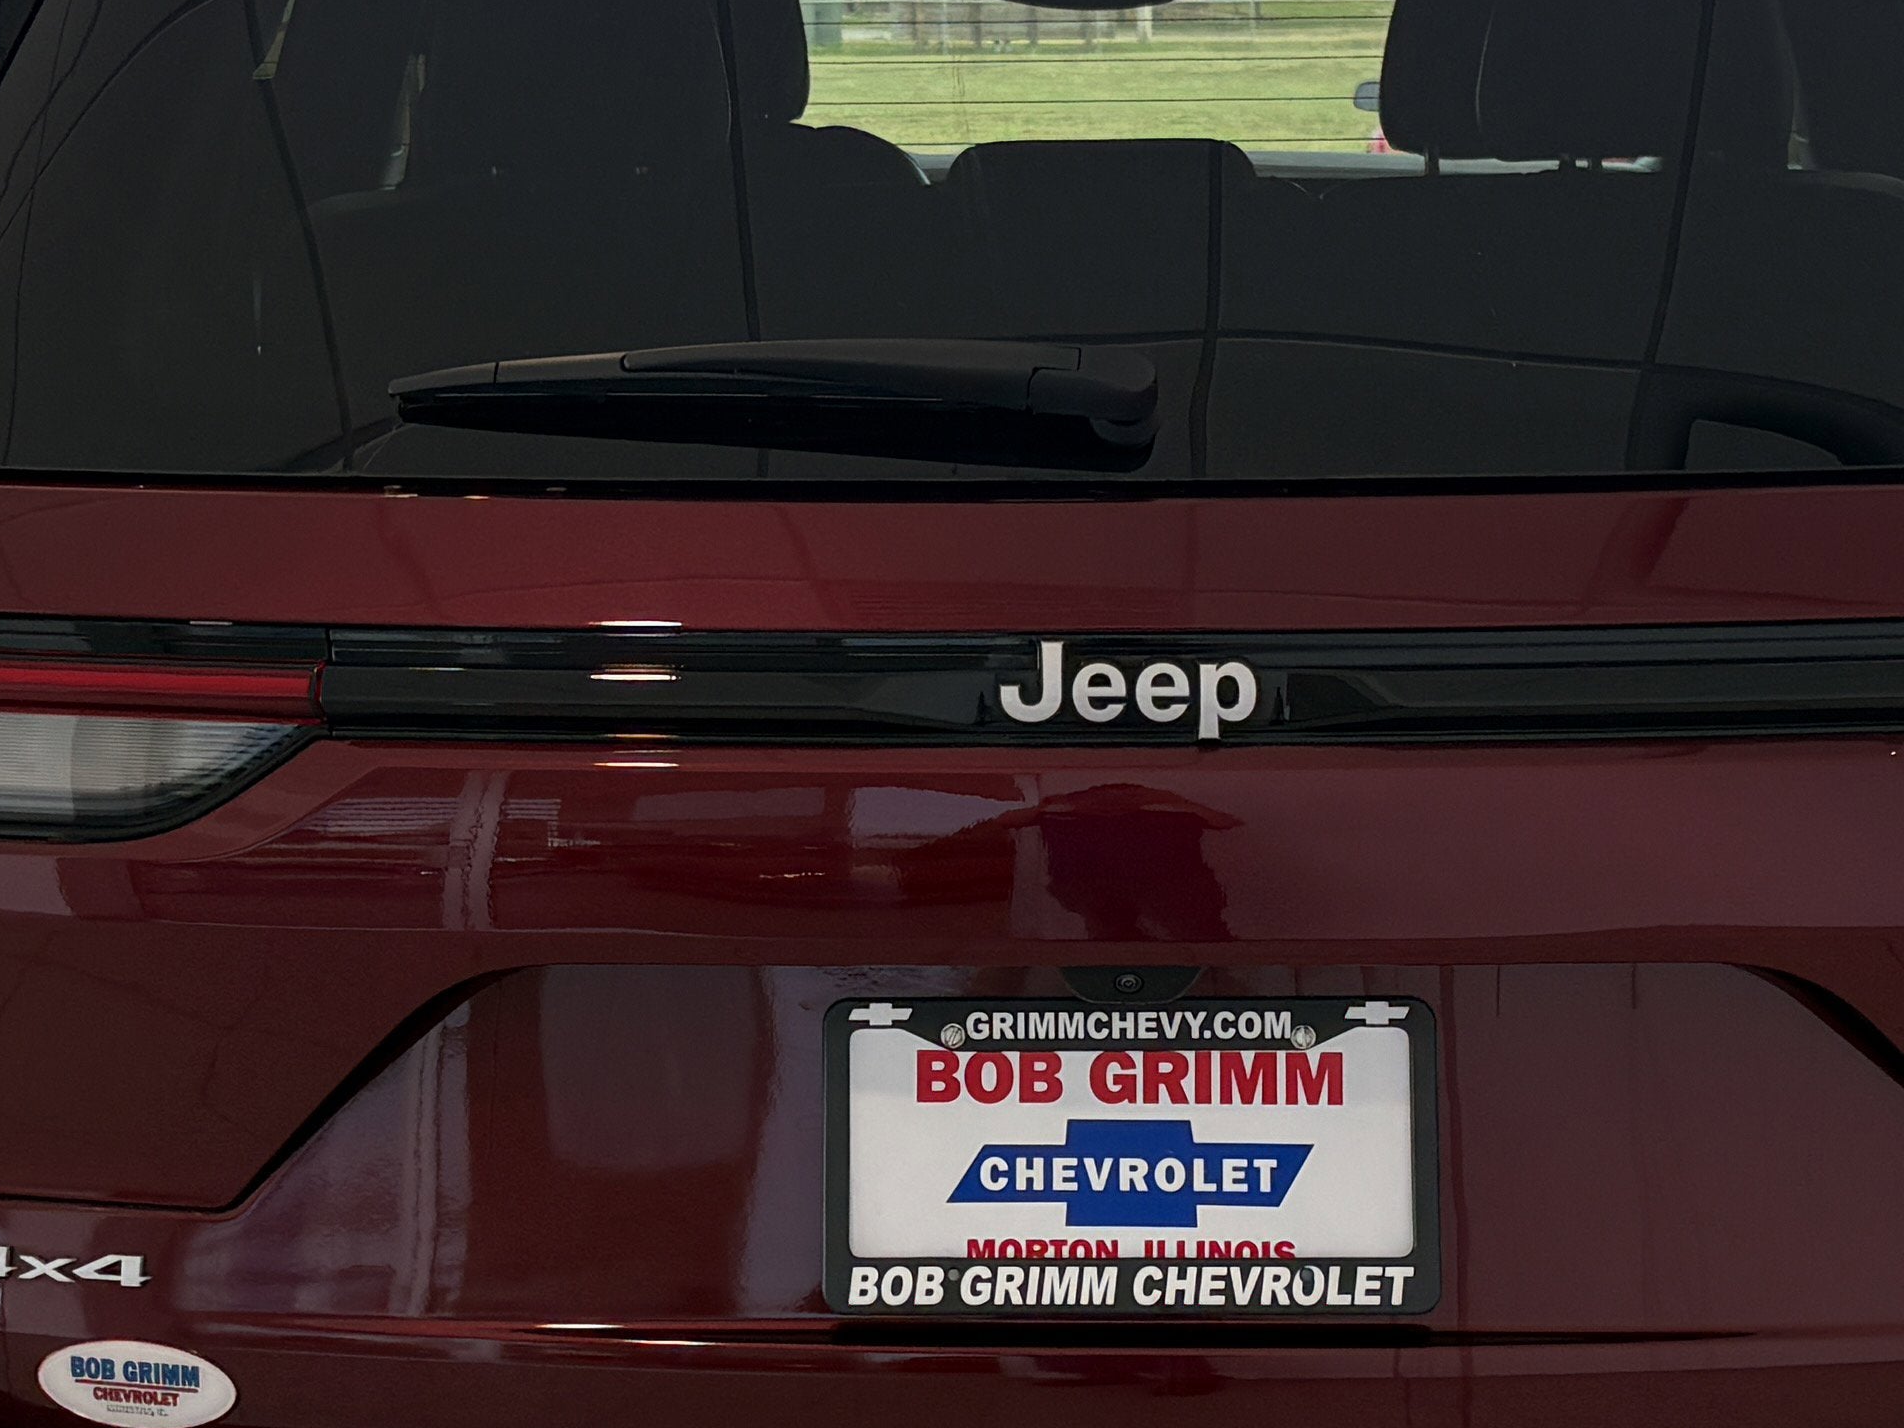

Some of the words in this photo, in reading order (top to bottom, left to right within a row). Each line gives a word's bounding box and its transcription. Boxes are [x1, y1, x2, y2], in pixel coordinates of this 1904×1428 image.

[1000, 641, 1257, 740] Jeep
[966, 1010, 1292, 1042] GRIMMCHEVY.COM
[916, 1049, 1064, 1105] BOB
[1089, 1050, 1344, 1106] GRIMM
[979, 1158, 1279, 1193] CHEVROLET
[848, 1265, 946, 1306] BOB
[959, 1265, 1116, 1306] GRIMM
[1132, 1265, 1415, 1307] CHEVROLET
[70, 1355, 115, 1380] BOB
[123, 1360, 200, 1388] GRIMM
[93, 1386, 180, 1407] CHEVROLET
